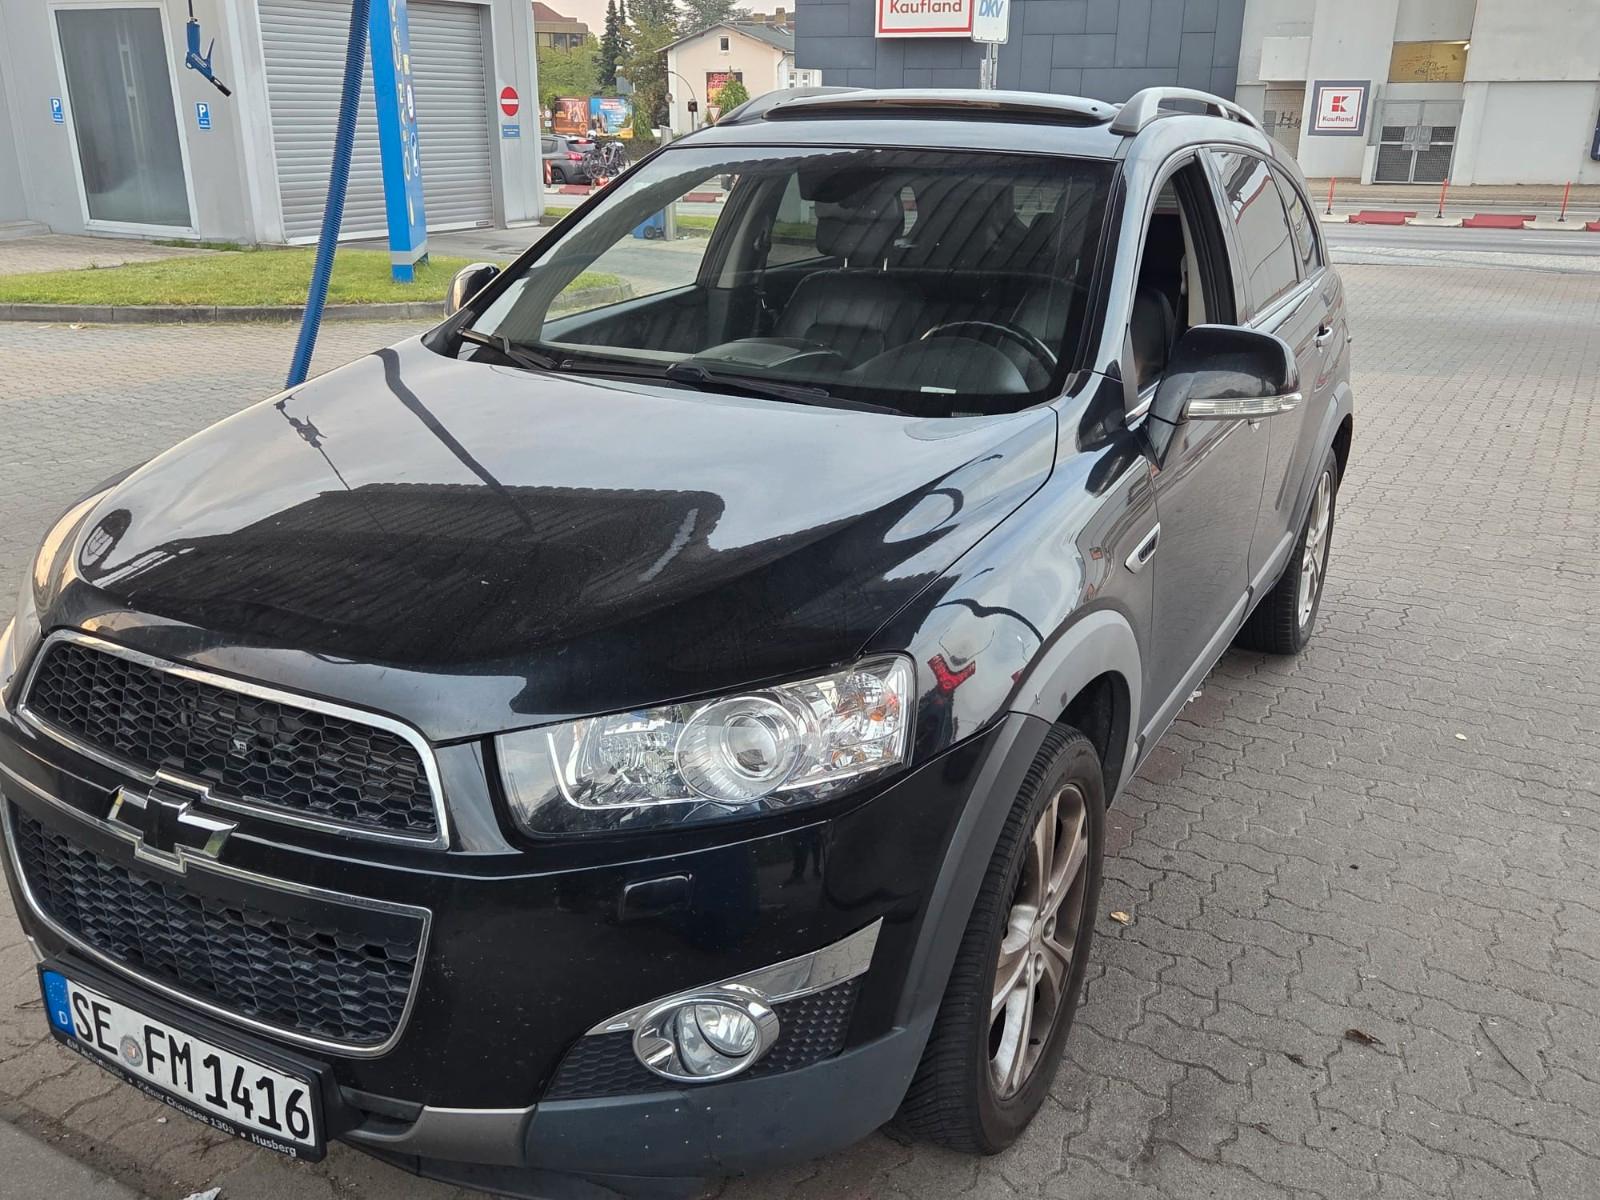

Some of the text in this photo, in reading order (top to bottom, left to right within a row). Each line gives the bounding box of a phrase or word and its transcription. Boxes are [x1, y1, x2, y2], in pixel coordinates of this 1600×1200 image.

[889, 0, 962, 14] Kaufland
[979, 0, 1004, 18] DKV
[1322, 115, 1354, 123] Kaufland
[58, 1010, 68, 1025] D
[72, 991, 119, 1056] SE
[211, 1117, 236, 1135] 130a
[251, 1132, 297, 1158] Husberg
